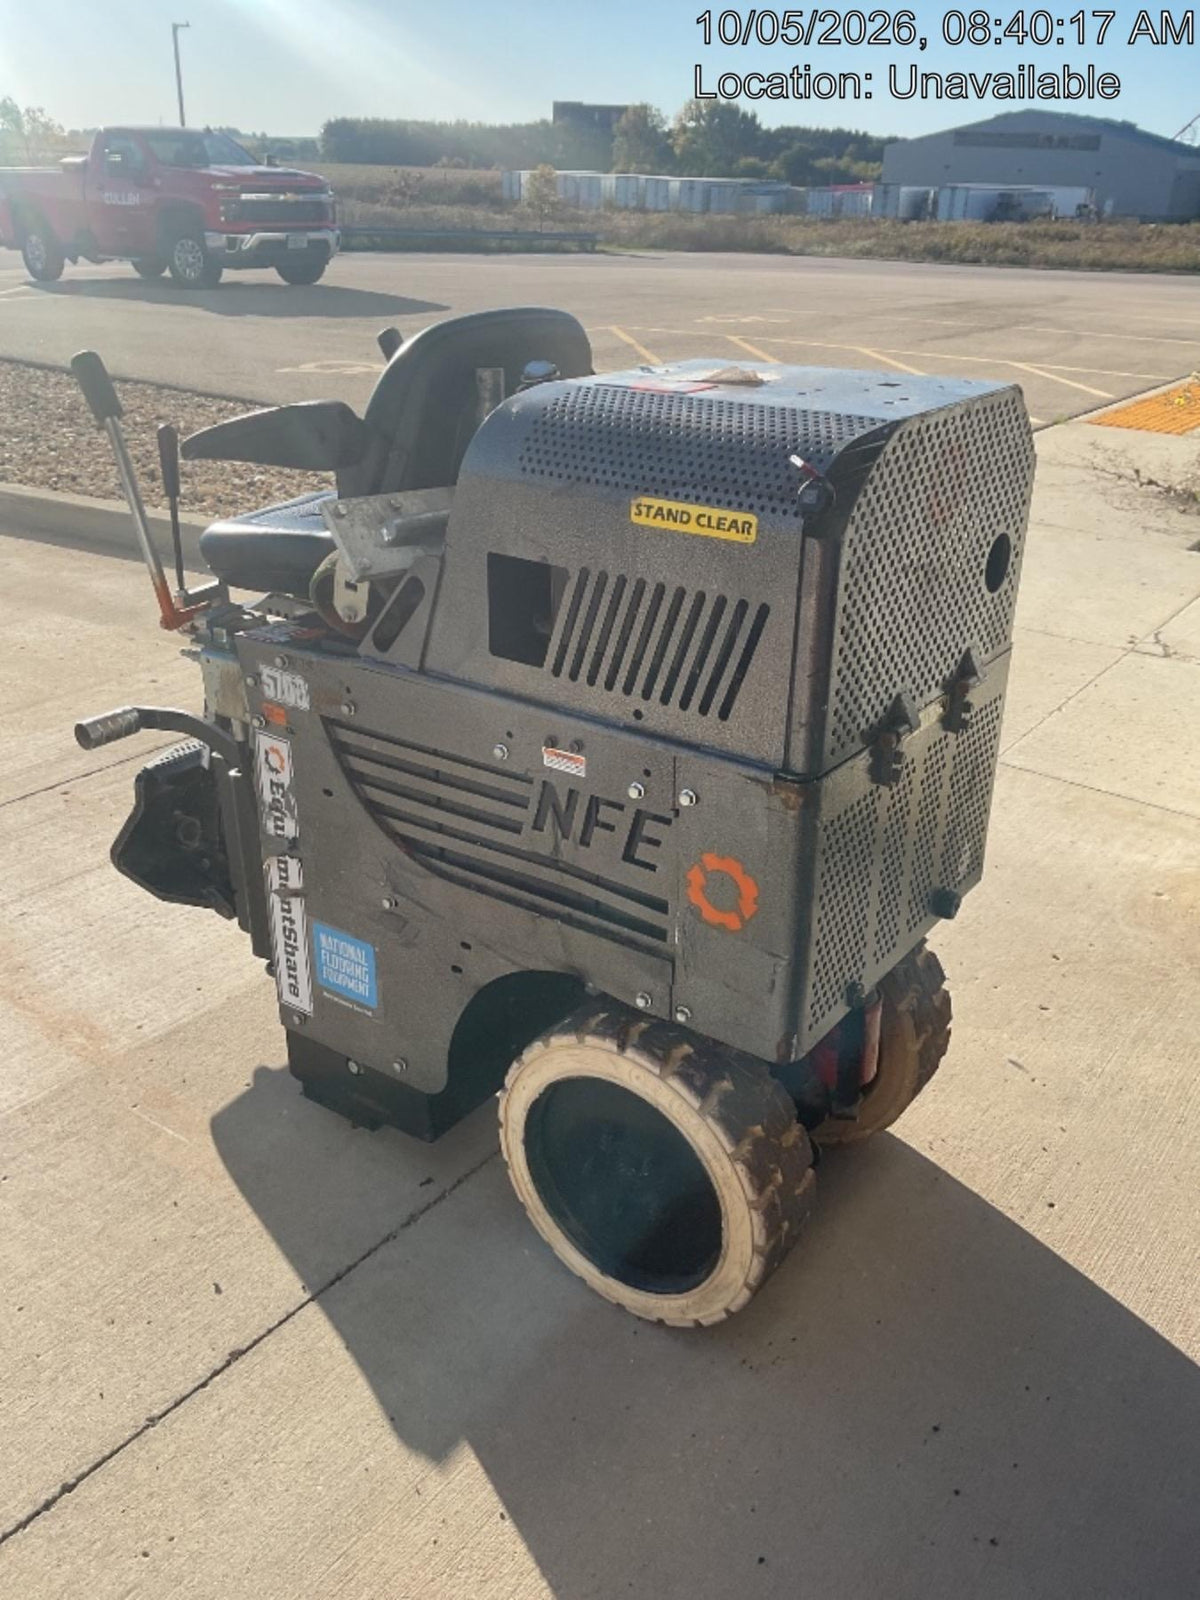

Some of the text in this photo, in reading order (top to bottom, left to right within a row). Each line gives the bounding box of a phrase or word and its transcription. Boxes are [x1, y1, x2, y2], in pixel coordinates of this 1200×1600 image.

[634, 502, 754, 536] STAND CLEAR
[531, 780, 673, 873] NFE
